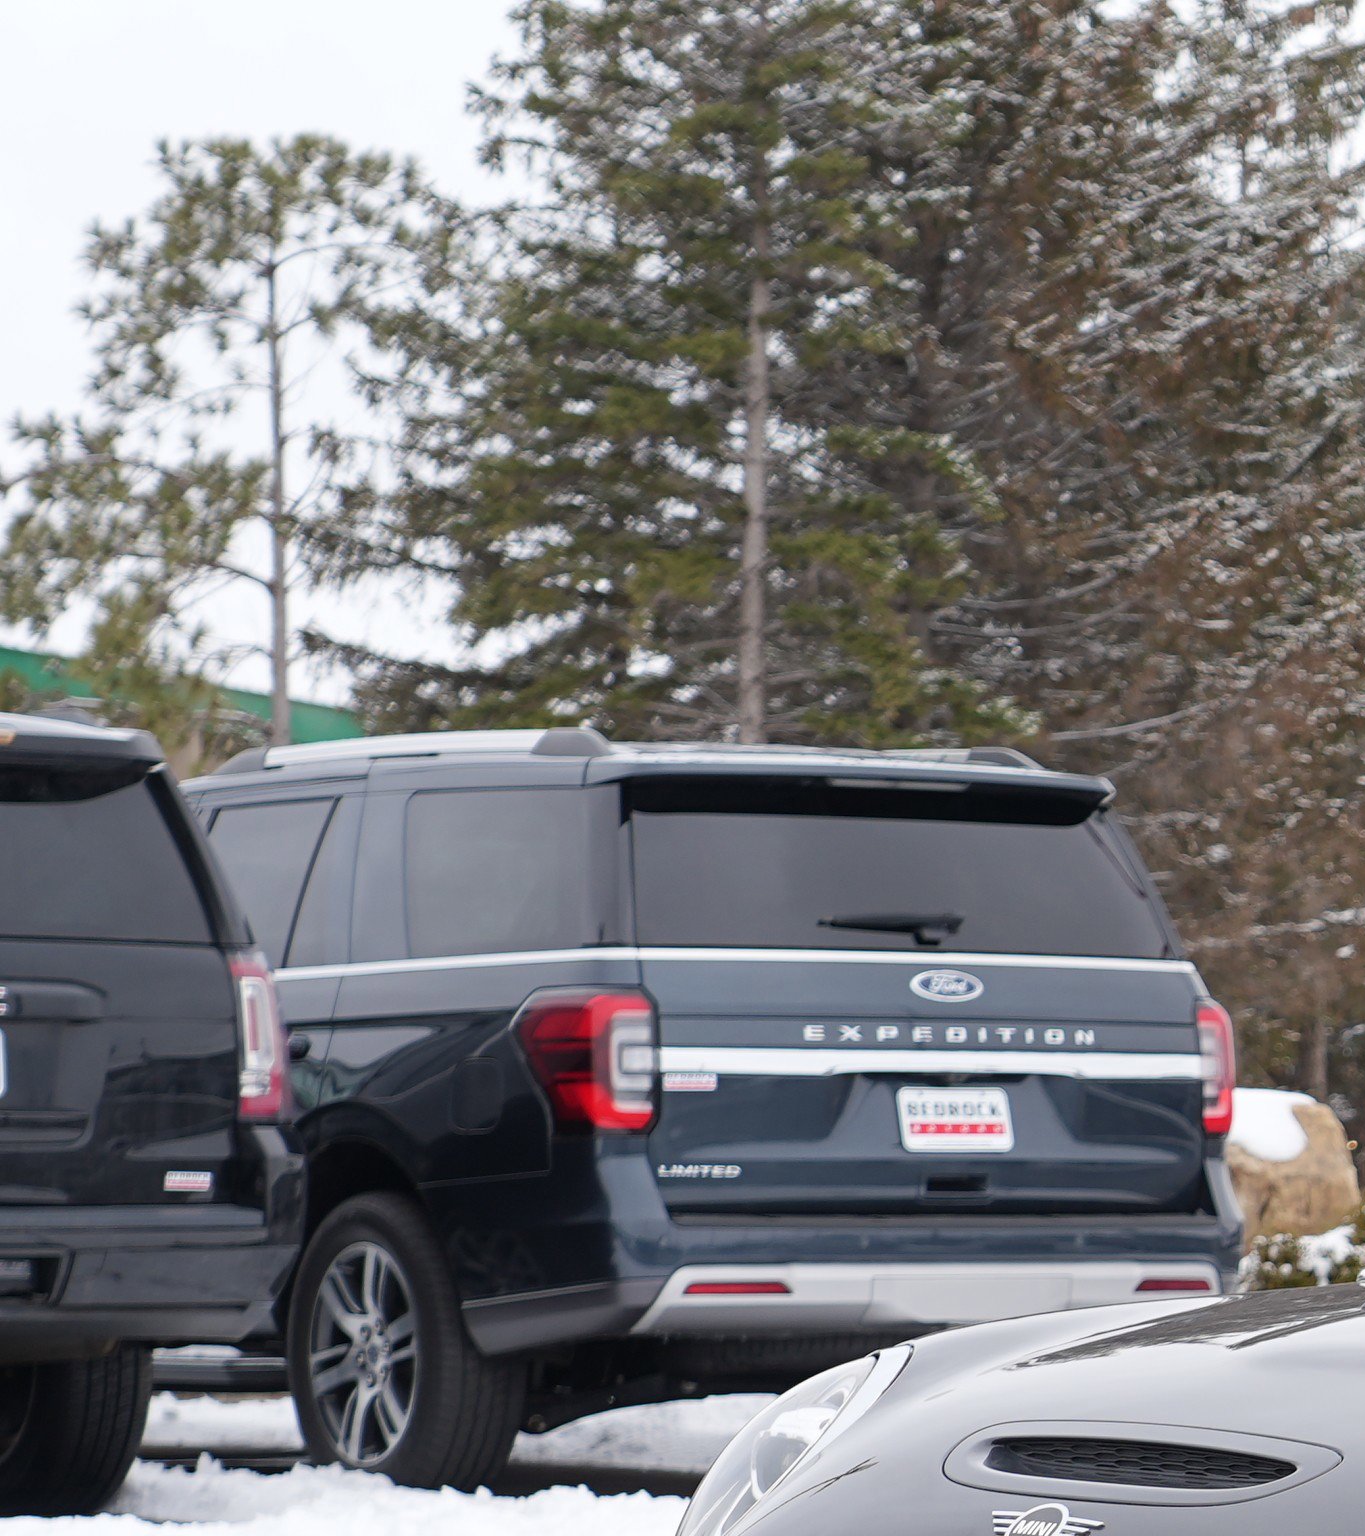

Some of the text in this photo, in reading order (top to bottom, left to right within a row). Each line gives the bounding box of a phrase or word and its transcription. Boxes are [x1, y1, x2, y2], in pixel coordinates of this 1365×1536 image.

[930, 974, 968, 995] Ford
[802, 1024, 1096, 1046] EXPEDITION
[907, 1101, 1002, 1116] BEDROCK
[657, 1164, 742, 1178] LIMITED
[1012, 1519, 1058, 1536] MINI
